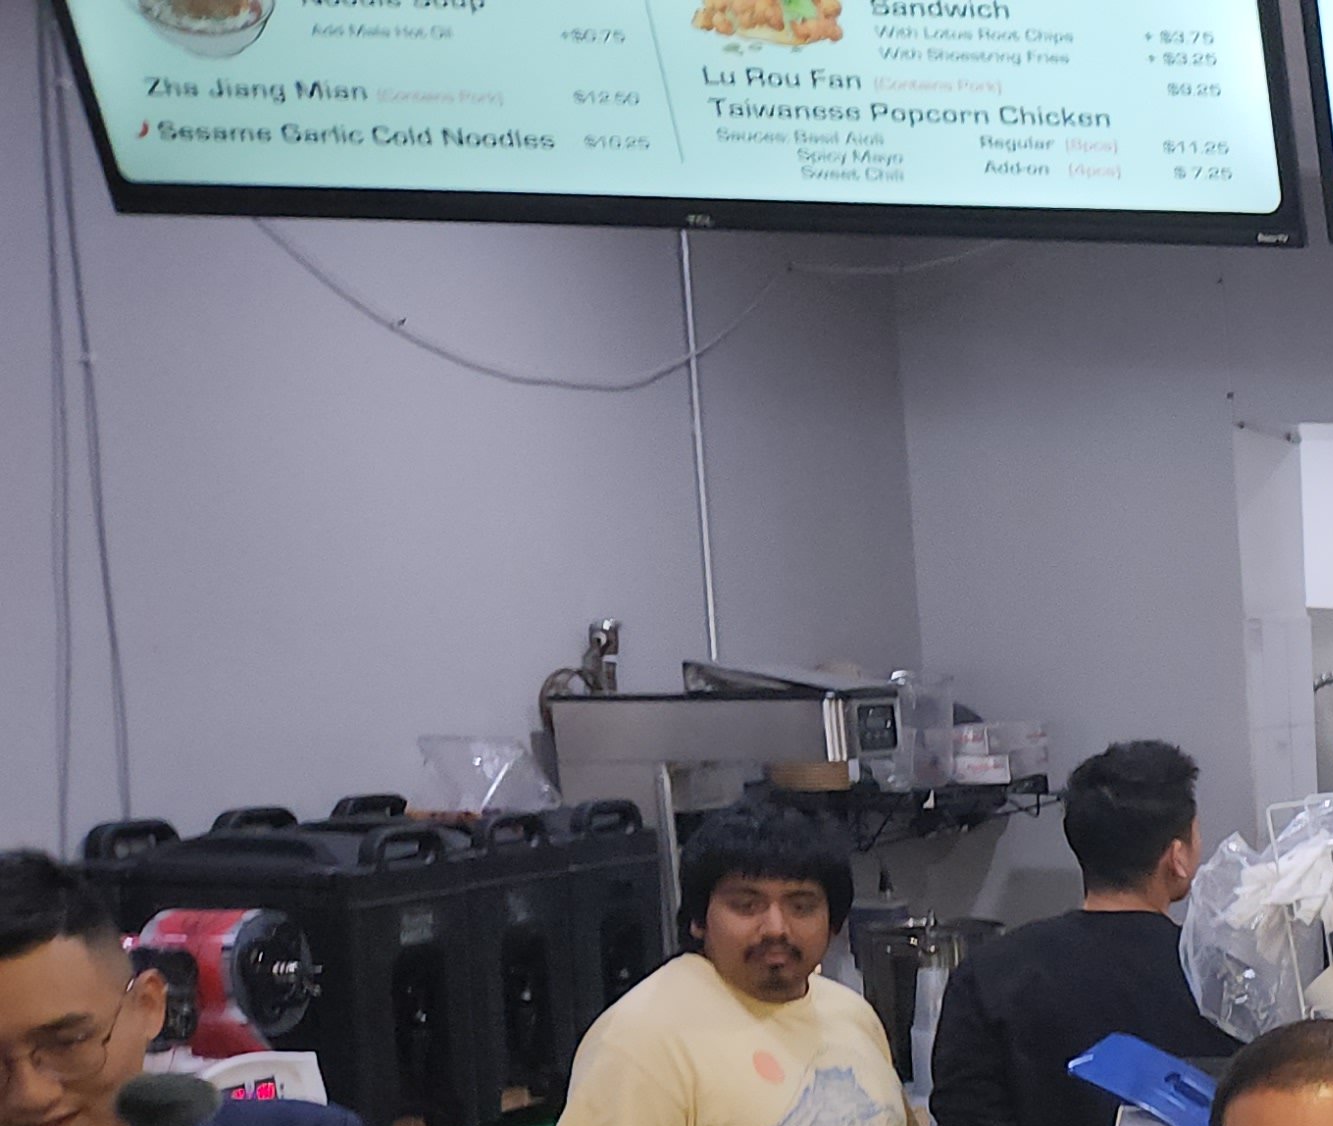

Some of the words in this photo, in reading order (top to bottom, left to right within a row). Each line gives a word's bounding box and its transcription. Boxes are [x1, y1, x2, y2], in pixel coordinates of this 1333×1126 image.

[870, 0, 1011, 20] Sandwich
[874, 25, 919, 40] With
[923, 26, 973, 41] Lotus
[977, 27, 1021, 42] Root
[1025, 28, 1075, 45] Chips
[1026, 49, 1071, 65] Fries
[702, 65, 736, 87] Lu
[745, 67, 801, 88] Rou
[810, 69, 862, 90] Fan
[145, 77, 199, 97] Zha
[208, 78, 286, 104] Jiang
[294, 80, 369, 100] Mian
[707, 97, 862, 122] Taiwanese
[870, 102, 990, 127] Popcorn
[999, 105, 1112, 128] Chicken
[157, 121, 273, 142] Sesame
[281, 123, 365, 145] Garlic
[372, 124, 433, 147] Cold
[442, 127, 555, 150] Noodles
[979, 135, 1055, 153] Regular
